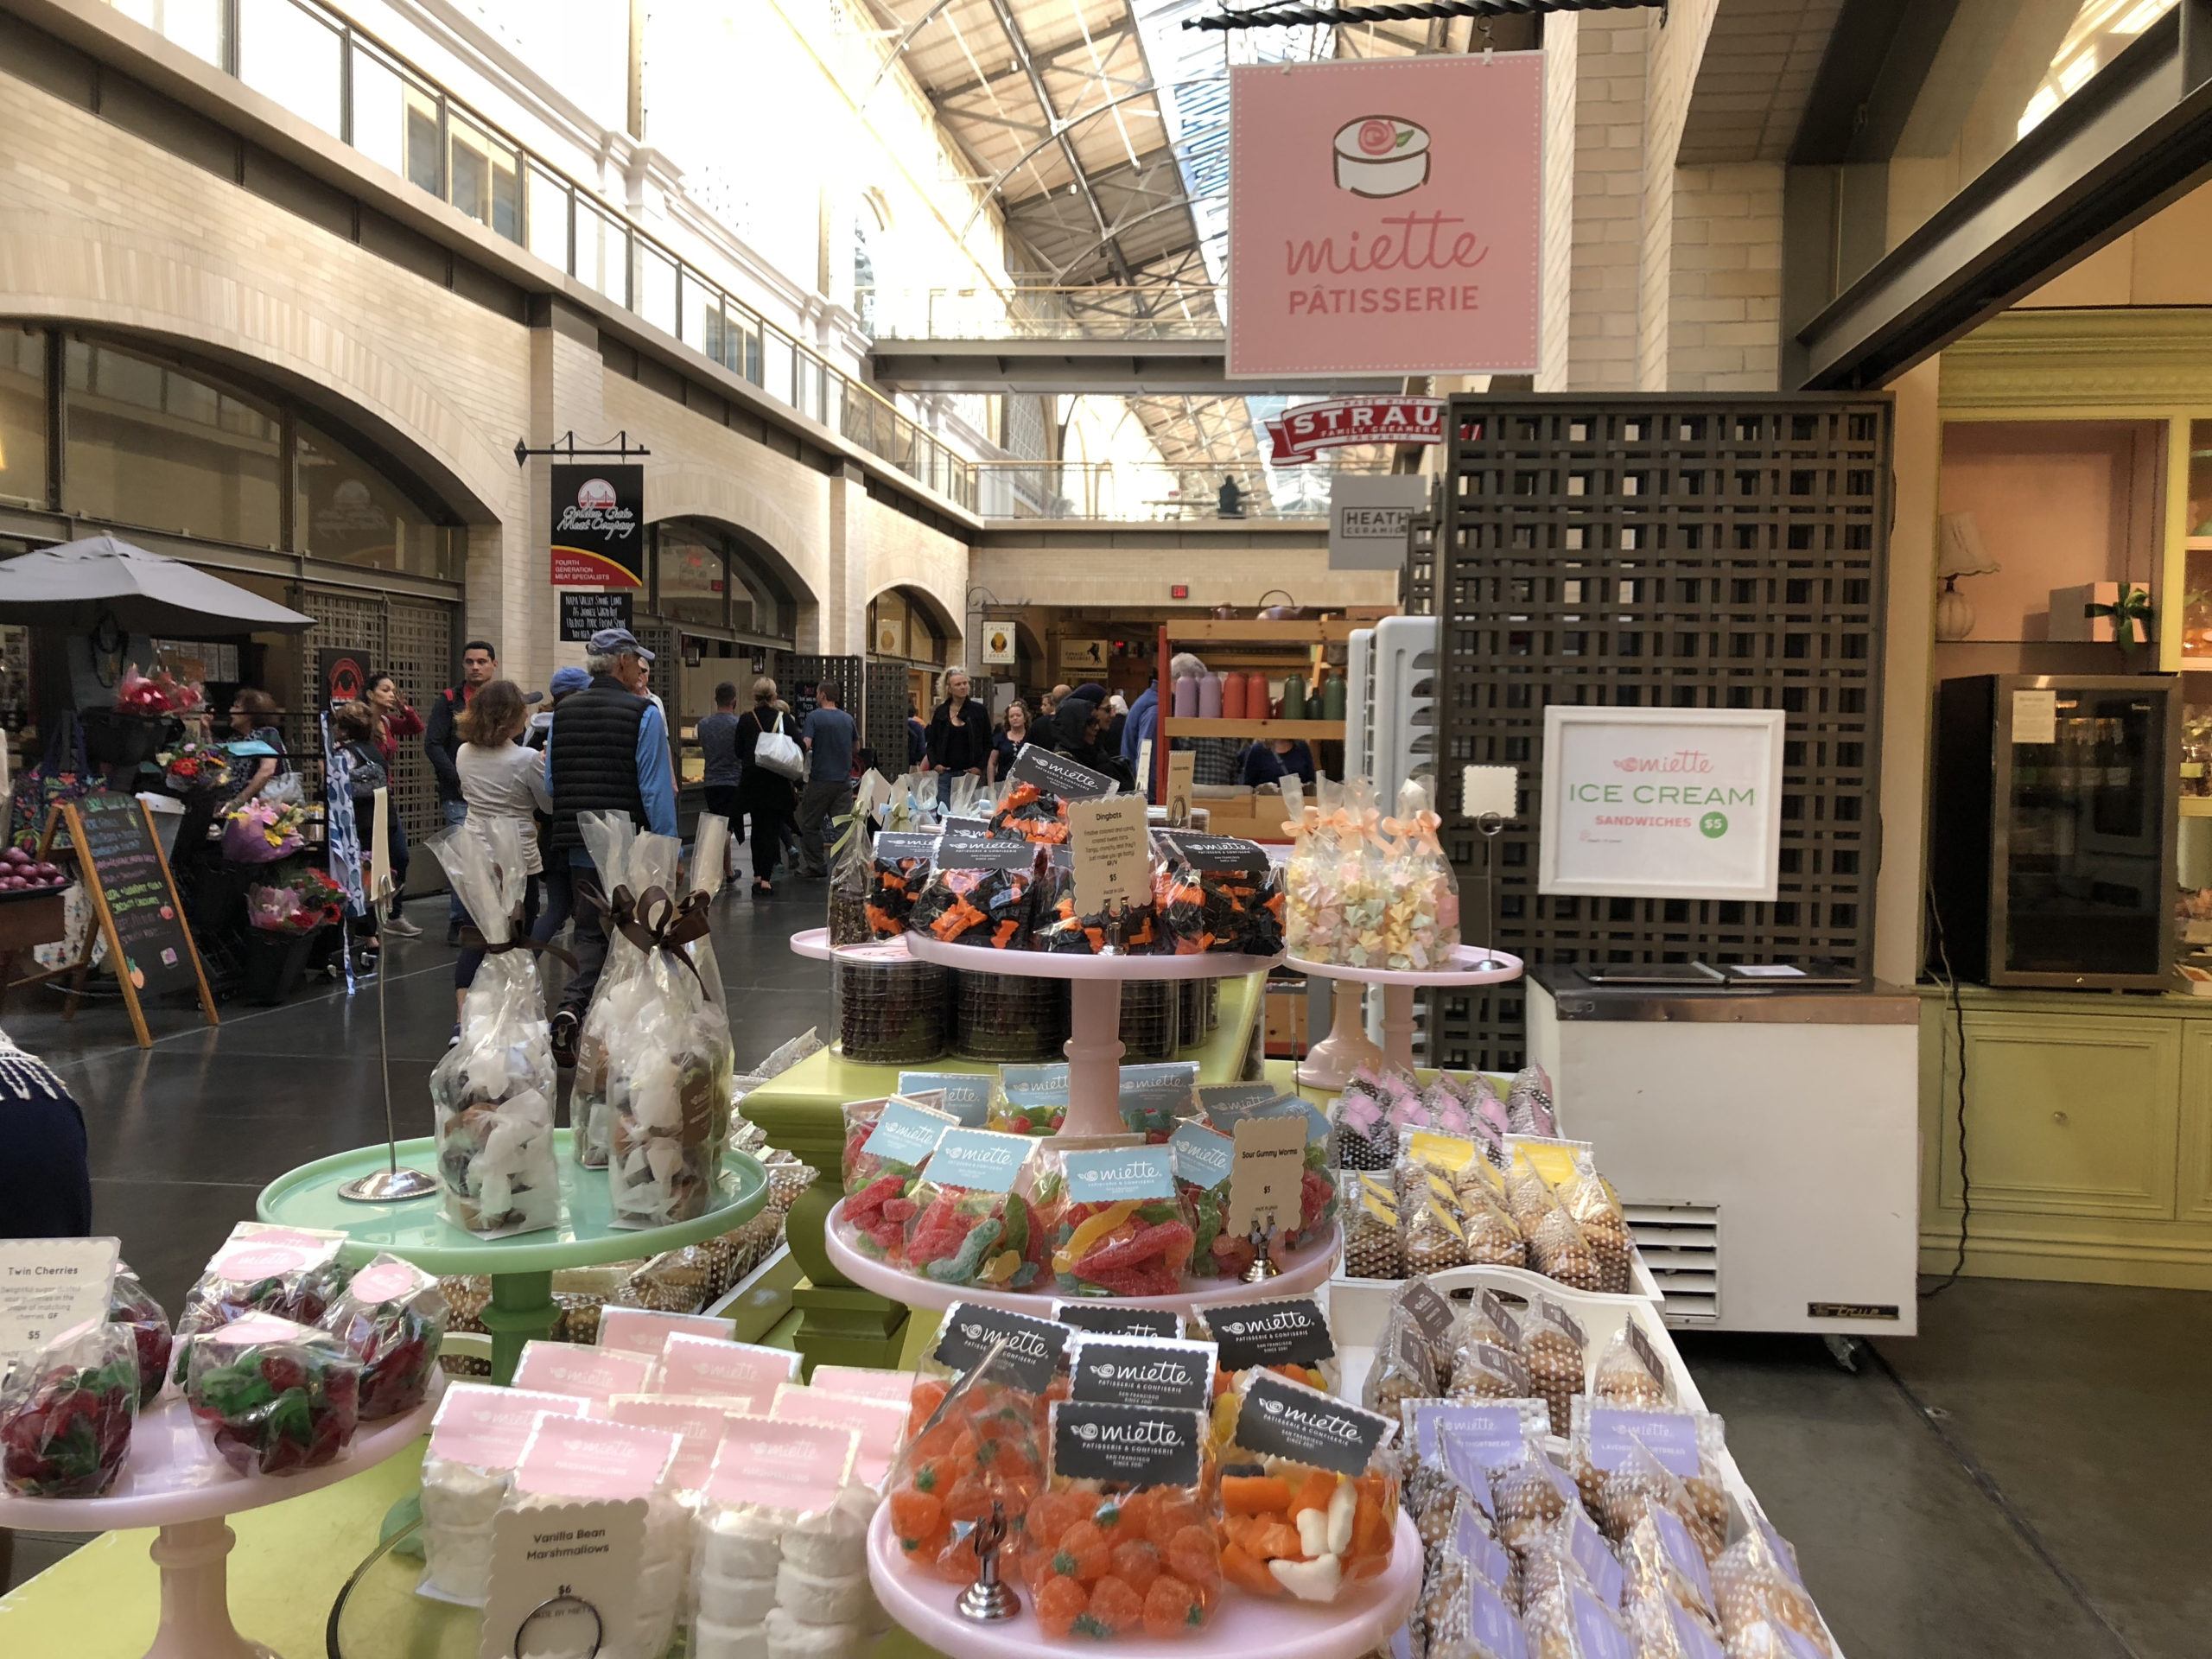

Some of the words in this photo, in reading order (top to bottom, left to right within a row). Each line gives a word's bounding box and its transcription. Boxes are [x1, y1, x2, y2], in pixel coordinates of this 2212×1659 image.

[1286, 210, 1490, 276] miette
[1288, 284, 1479, 315] PÂTISSERIE
[1293, 406, 1440, 434] STRAU
[1320, 426, 1364, 438] FAMILY
[1371, 425, 1439, 434] CREAMERY
[1640, 750, 1714, 774] miette
[1048, 763, 1098, 789] miette
[1569, 784, 1624, 803] ICE
[1632, 785, 1755, 807] CREAM
[1096, 811, 1122, 822] Dingbats
[1595, 815, 1693, 829] SANDWICHES
[1704, 817, 1723, 830] $5
[1109, 873, 1117, 882] $5
[1030, 1074, 1070, 1092] miett
[1136, 1073, 1183, 1090] miette
[947, 1087, 976, 1103] ette
[1229, 1095, 1265, 1110] miett
[896, 1125, 934, 1145] miette
[962, 1147, 1012, 1166] miette
[1187, 1144, 1228, 1168] miette
[1243, 1150, 1255, 1159] Sour
[1256, 1149, 1277, 1159] Gummy
[1278, 1147, 1298, 1156] Worms
[1100, 1161, 1160, 1180] miette
[1263, 1185, 1272, 1194] $5
[8, 1267, 32, 1276] Twin
[35, 1266, 79, 1275] Cherries
[1246, 1311, 1312, 1333] miette
[28, 1331, 41, 1340] $5
[1274, 1330, 1309, 1338] CONFISERIE
[963, 1340, 988, 1351] PATISSE
[1002, 1351, 1037, 1365] CONFISERIE
[1117, 1361, 1191, 1384] miette
[1098, 1379, 1135, 1389] PATISSERIE
[1142, 1384, 1182, 1394] CONFISERIE
[1129, 1391, 1160, 1400] FRANCISCO
[492, 1409, 534, 1425] miett
[1285, 1406, 1362, 1440] miette
[1102, 1420, 1182, 1446] miette
[1263, 1414, 1300, 1429] PATISSERIE
[1308, 1428, 1349, 1446] CONFISERIE
[1293, 1432, 1324, 1446] FRANCISCO
[1082, 1441, 1122, 1452] PATISSERIE
[1131, 1446, 1173, 1456] CONFISERIE
[1118, 1454, 1151, 1463] FRANCISCO
[533, 1529, 574, 1544] Vanilla
[576, 1528, 606, 1540] Bean
[526, 1543, 610, 1560] Marshmallows
[558, 1584, 572, 1597] $6
